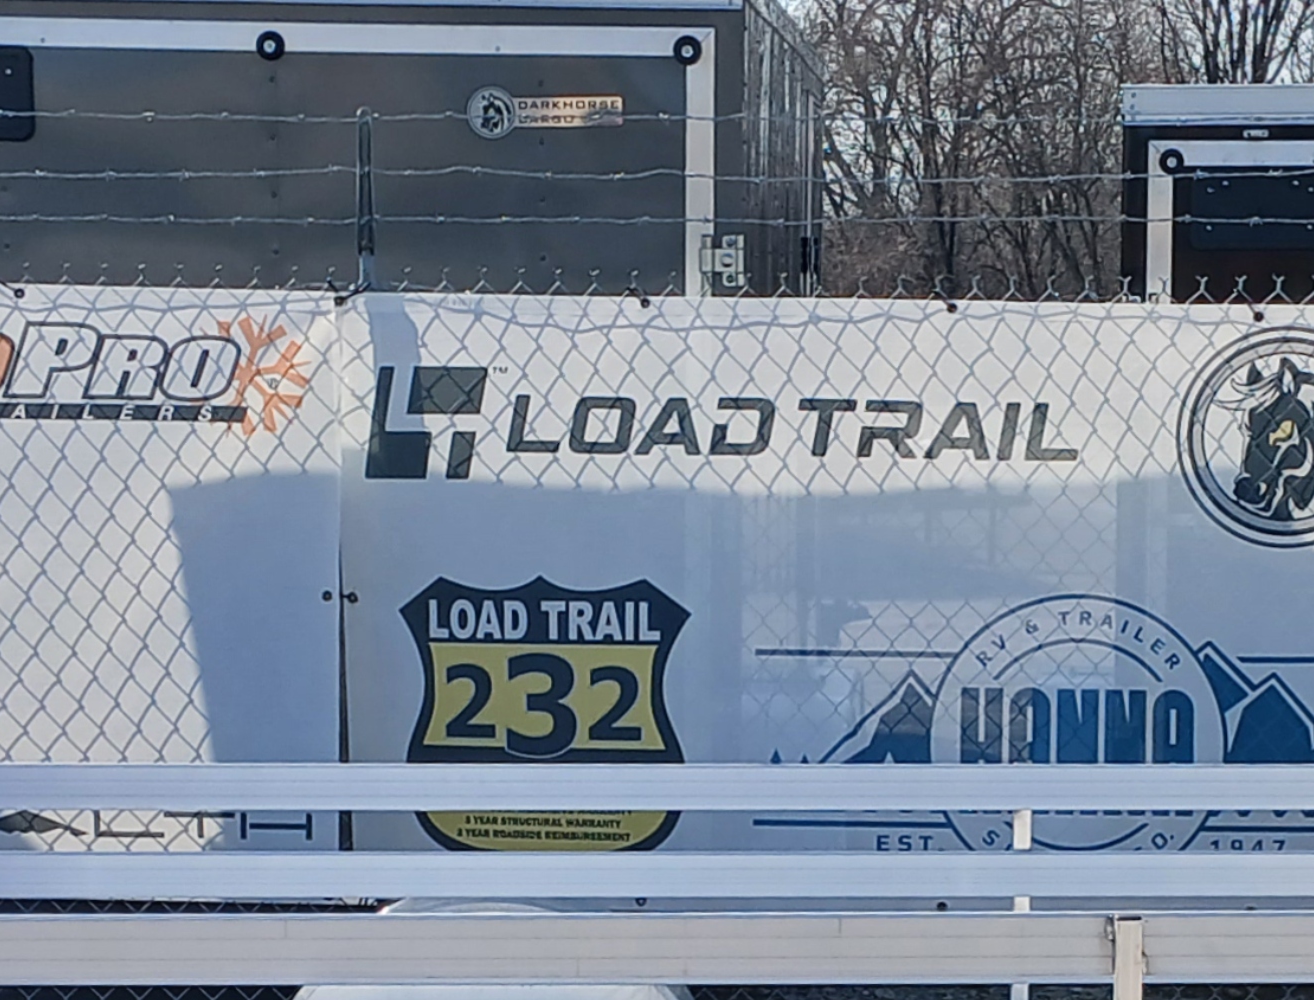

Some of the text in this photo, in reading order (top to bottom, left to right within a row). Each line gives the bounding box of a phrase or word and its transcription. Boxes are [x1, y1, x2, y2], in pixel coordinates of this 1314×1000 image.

[518, 100, 620, 110] DARKHORSE
[506, 394, 1079, 462] LOAD TRAIL
[429, 598, 662, 642] LOAD TRAIL
[975, 609, 1182, 671] RV & TRAILER
[445, 652, 642, 757] 232
[960, 687, 1195, 816] HANNA
[466, 828, 490, 838] YEAR
[473, 815, 498, 825] YEAR
[501, 816, 562, 828] STRUCTURAL
[566, 818, 621, 829] WARRANTY
[876, 835, 945, 852] EST.
